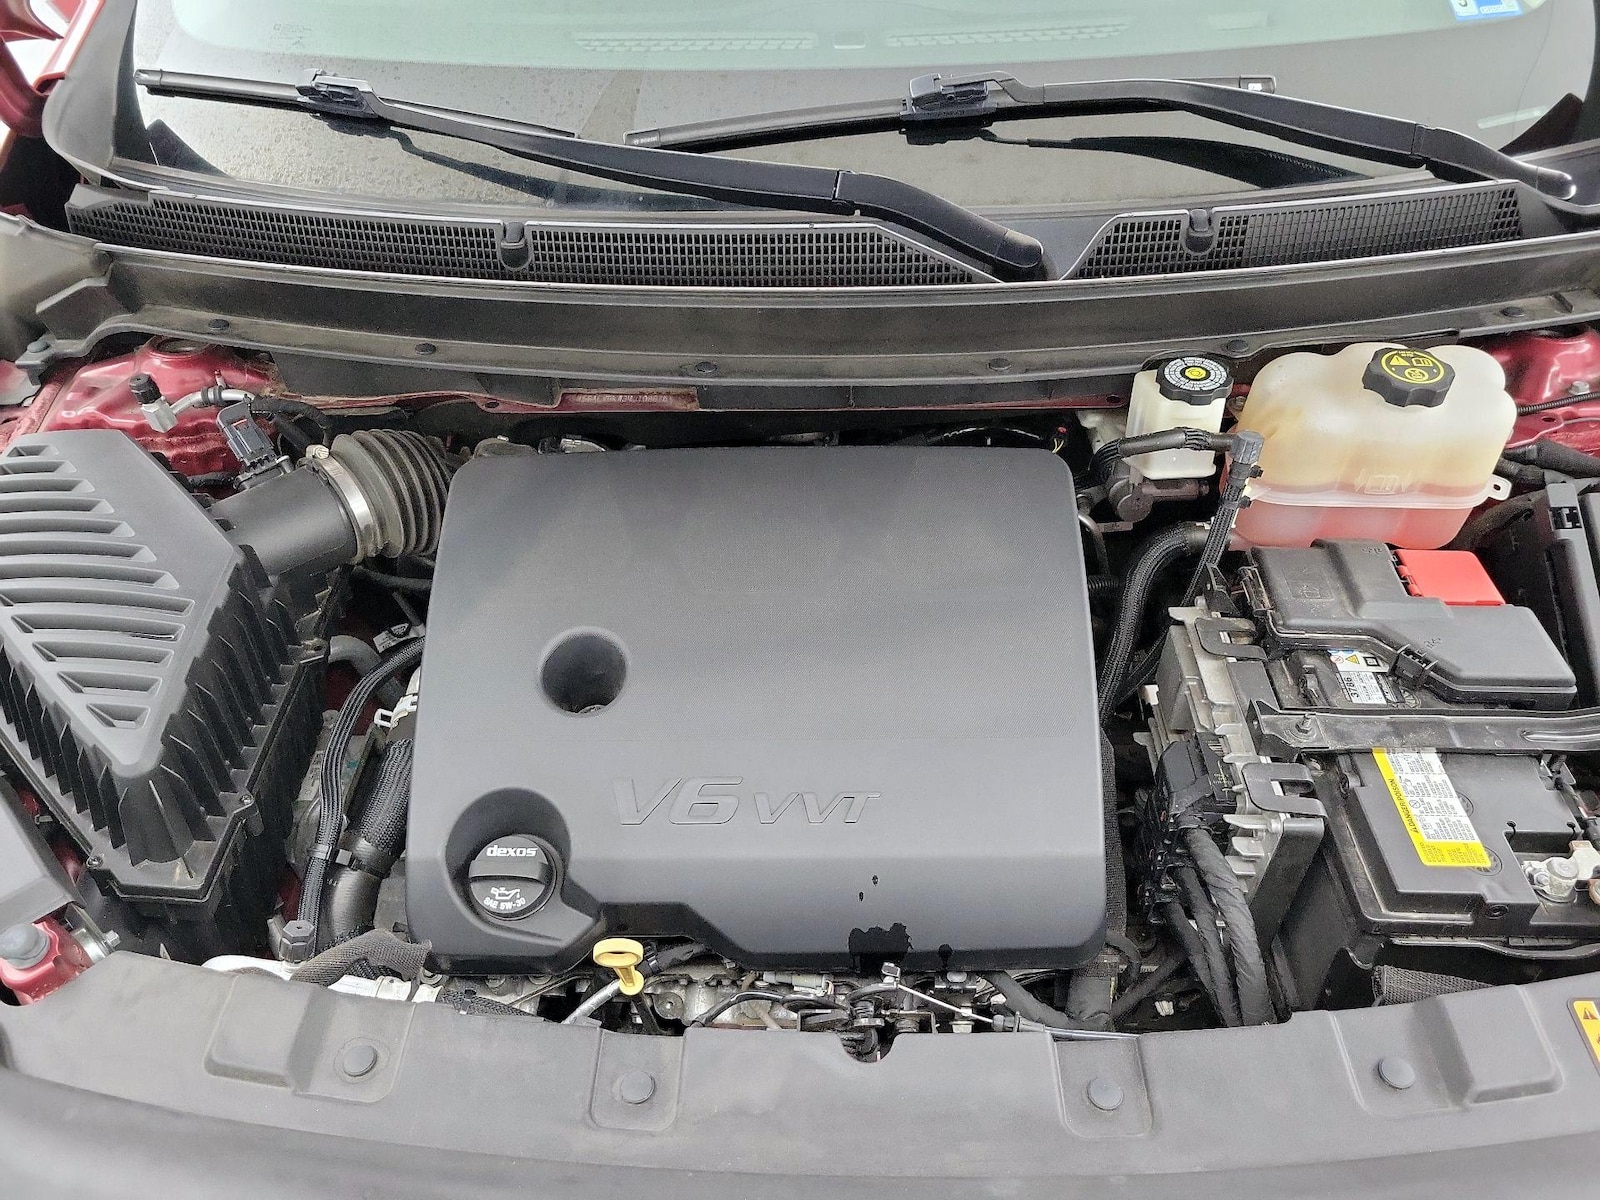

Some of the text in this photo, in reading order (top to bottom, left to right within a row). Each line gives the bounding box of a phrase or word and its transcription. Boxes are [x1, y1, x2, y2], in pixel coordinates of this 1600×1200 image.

[1343, 677, 1359, 698] 3786
[612, 776, 881, 825] V6 VVT
[486, 845, 538, 857] dexos
[483, 896, 526, 910] SAE 5W-30
